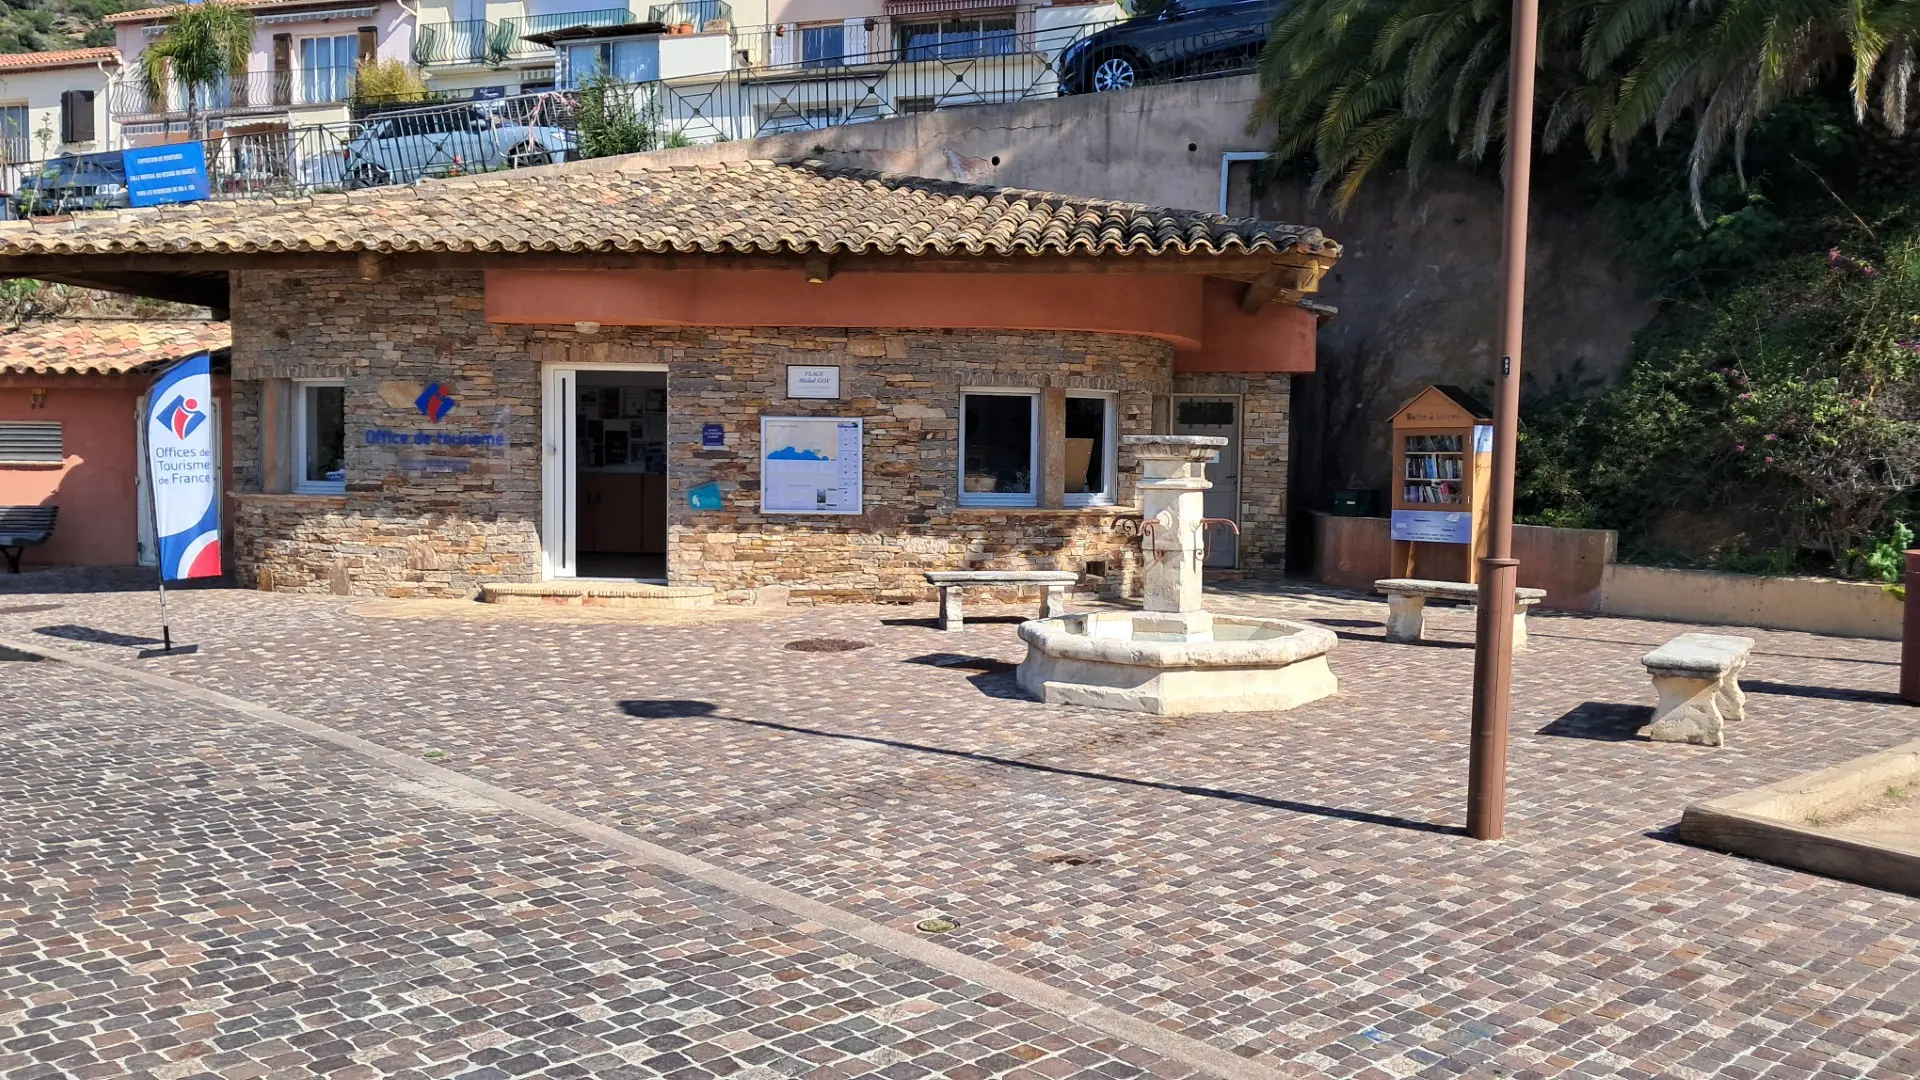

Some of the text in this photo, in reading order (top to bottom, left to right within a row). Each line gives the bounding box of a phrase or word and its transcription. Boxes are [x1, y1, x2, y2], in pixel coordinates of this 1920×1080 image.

[365, 429, 409, 445] Office
[413, 430, 432, 446] de
[156, 447, 210, 458] Offices de
[157, 460, 210, 471] Tourisme
[158, 472, 210, 484] de France
